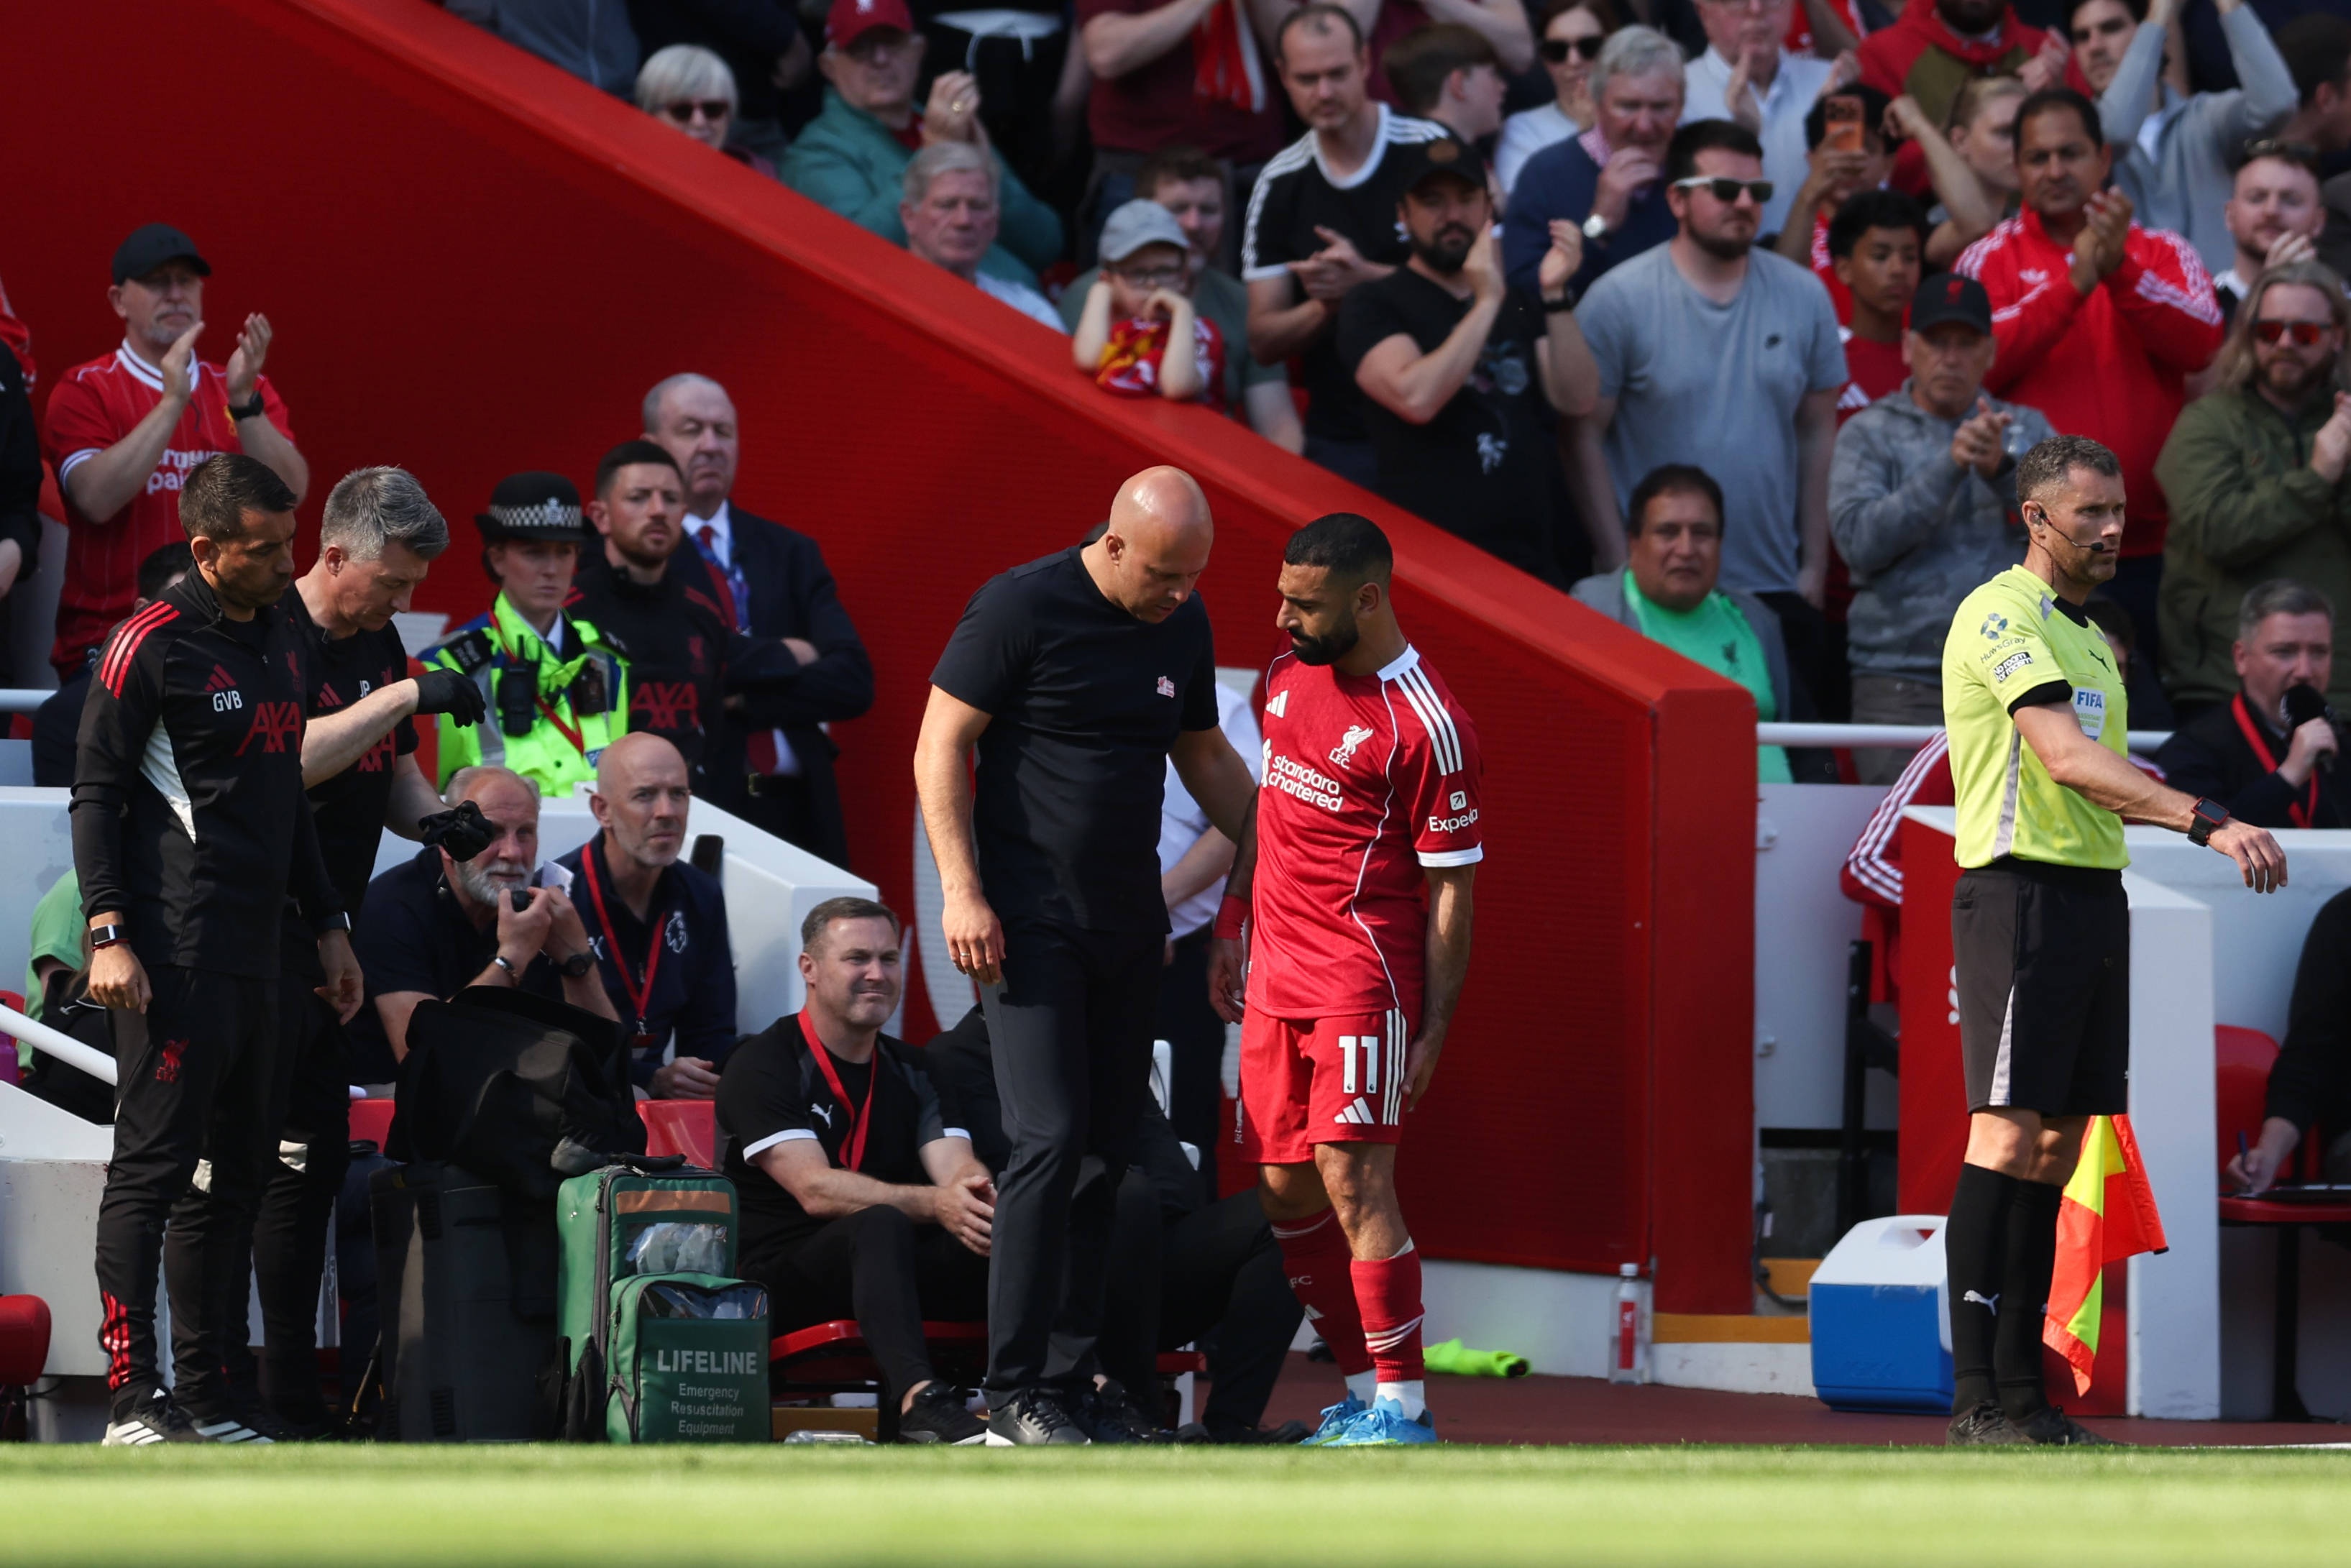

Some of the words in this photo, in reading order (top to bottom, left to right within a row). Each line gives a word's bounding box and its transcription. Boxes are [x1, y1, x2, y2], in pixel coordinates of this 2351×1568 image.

[159, 449, 223, 467] row
[359, 680, 370, 697] JP
[212, 690, 242, 712] GVB
[630, 682, 699, 729] AXA
[2077, 691, 2102, 709] FIFA
[234, 701, 303, 756] AXA
[357, 728, 398, 771] XA
[1268, 771, 1344, 812] chartered
[1339, 1036, 1378, 1094] 11
[657, 1349, 757, 1375] LIFELINE
[679, 1383, 739, 1401] Emergency
[671, 1401, 743, 1417] Resuscitation
[679, 1420, 735, 1436] Equipment
